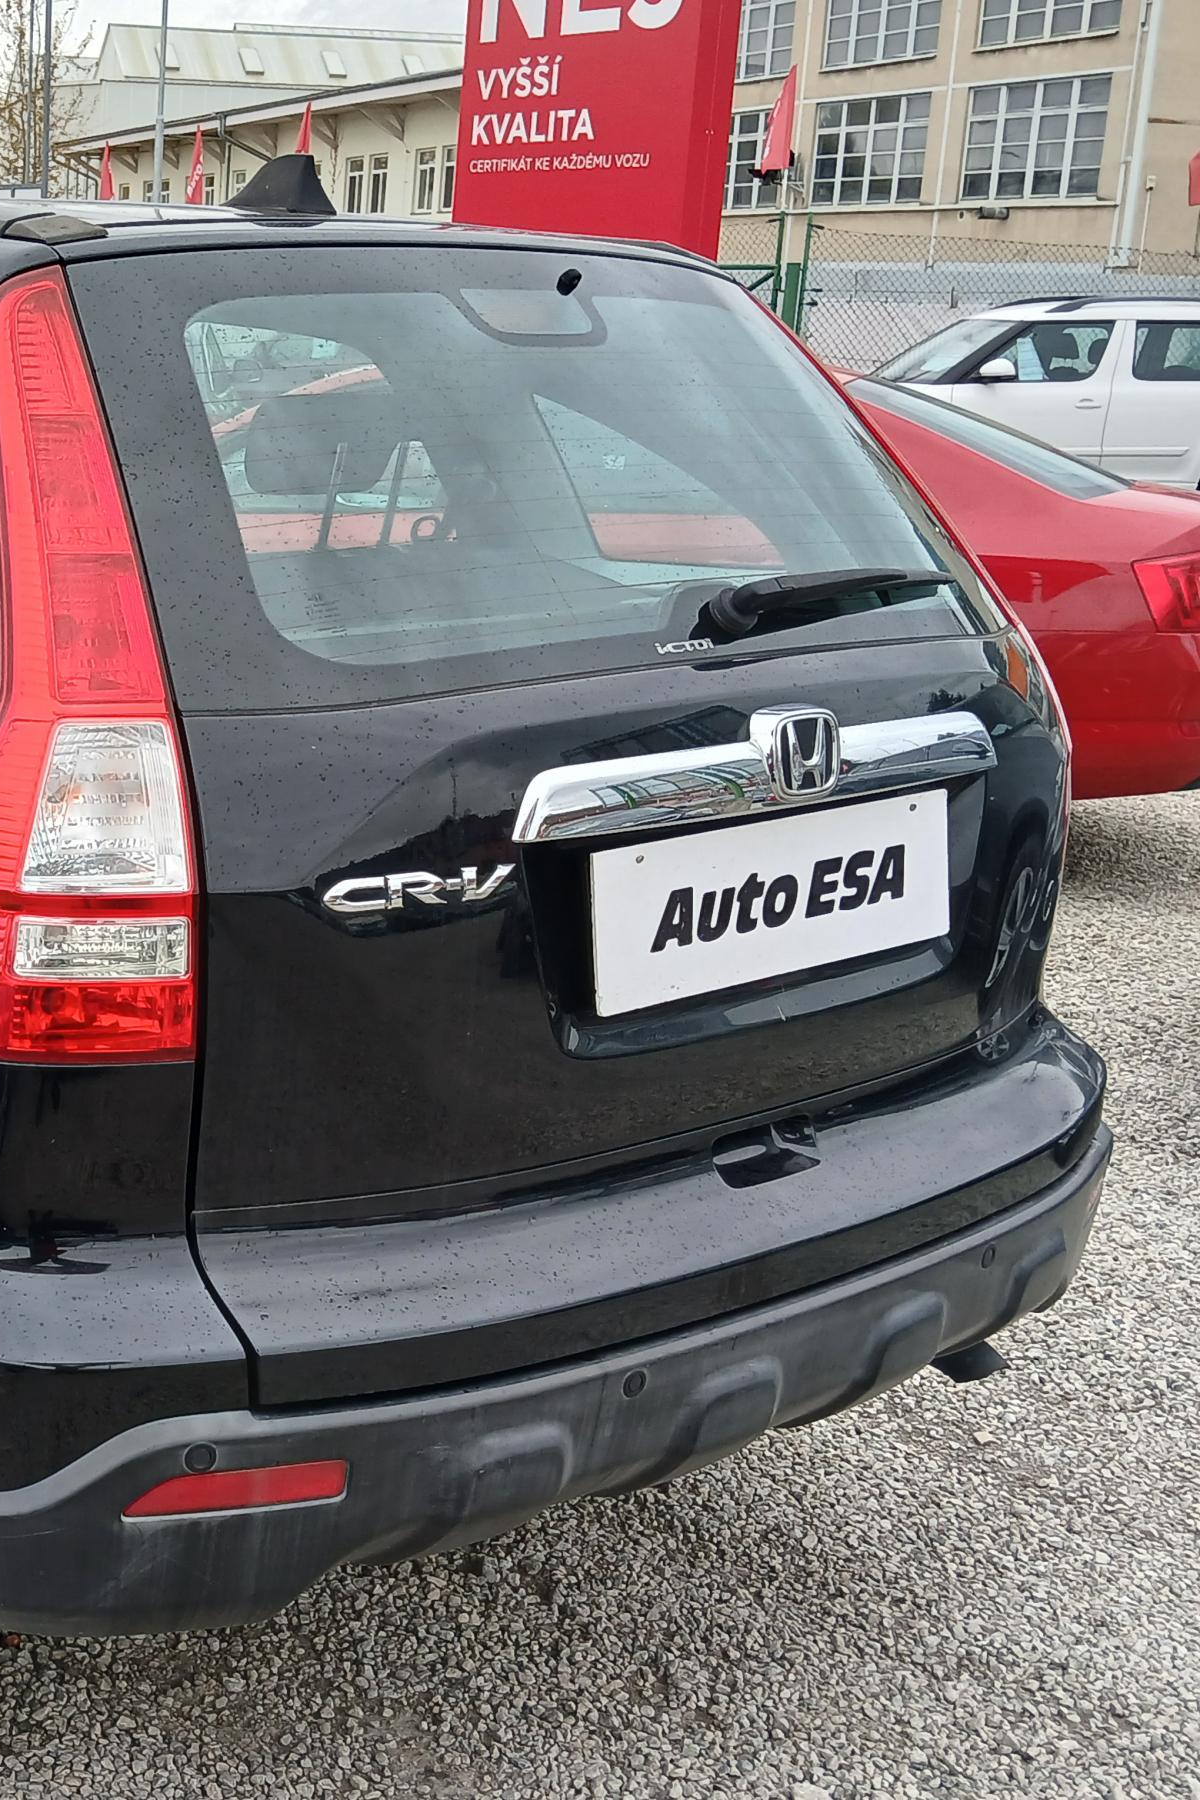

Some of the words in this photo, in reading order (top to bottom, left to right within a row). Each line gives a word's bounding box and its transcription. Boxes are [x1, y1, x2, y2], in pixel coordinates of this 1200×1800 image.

[477, 55, 563, 101] VYŠŠÍ
[470, 108, 595, 146] KVALITA
[469, 155, 534, 174] CERTIFIKÁT
[535, 158, 550, 171] KE
[553, 151, 612, 170] KAŽDÉMU
[615, 153, 650, 168] VOZU
[323, 863, 516, 913] CR-V
[650, 872, 798, 954] Auto
[804, 844, 905, 919] ESA
